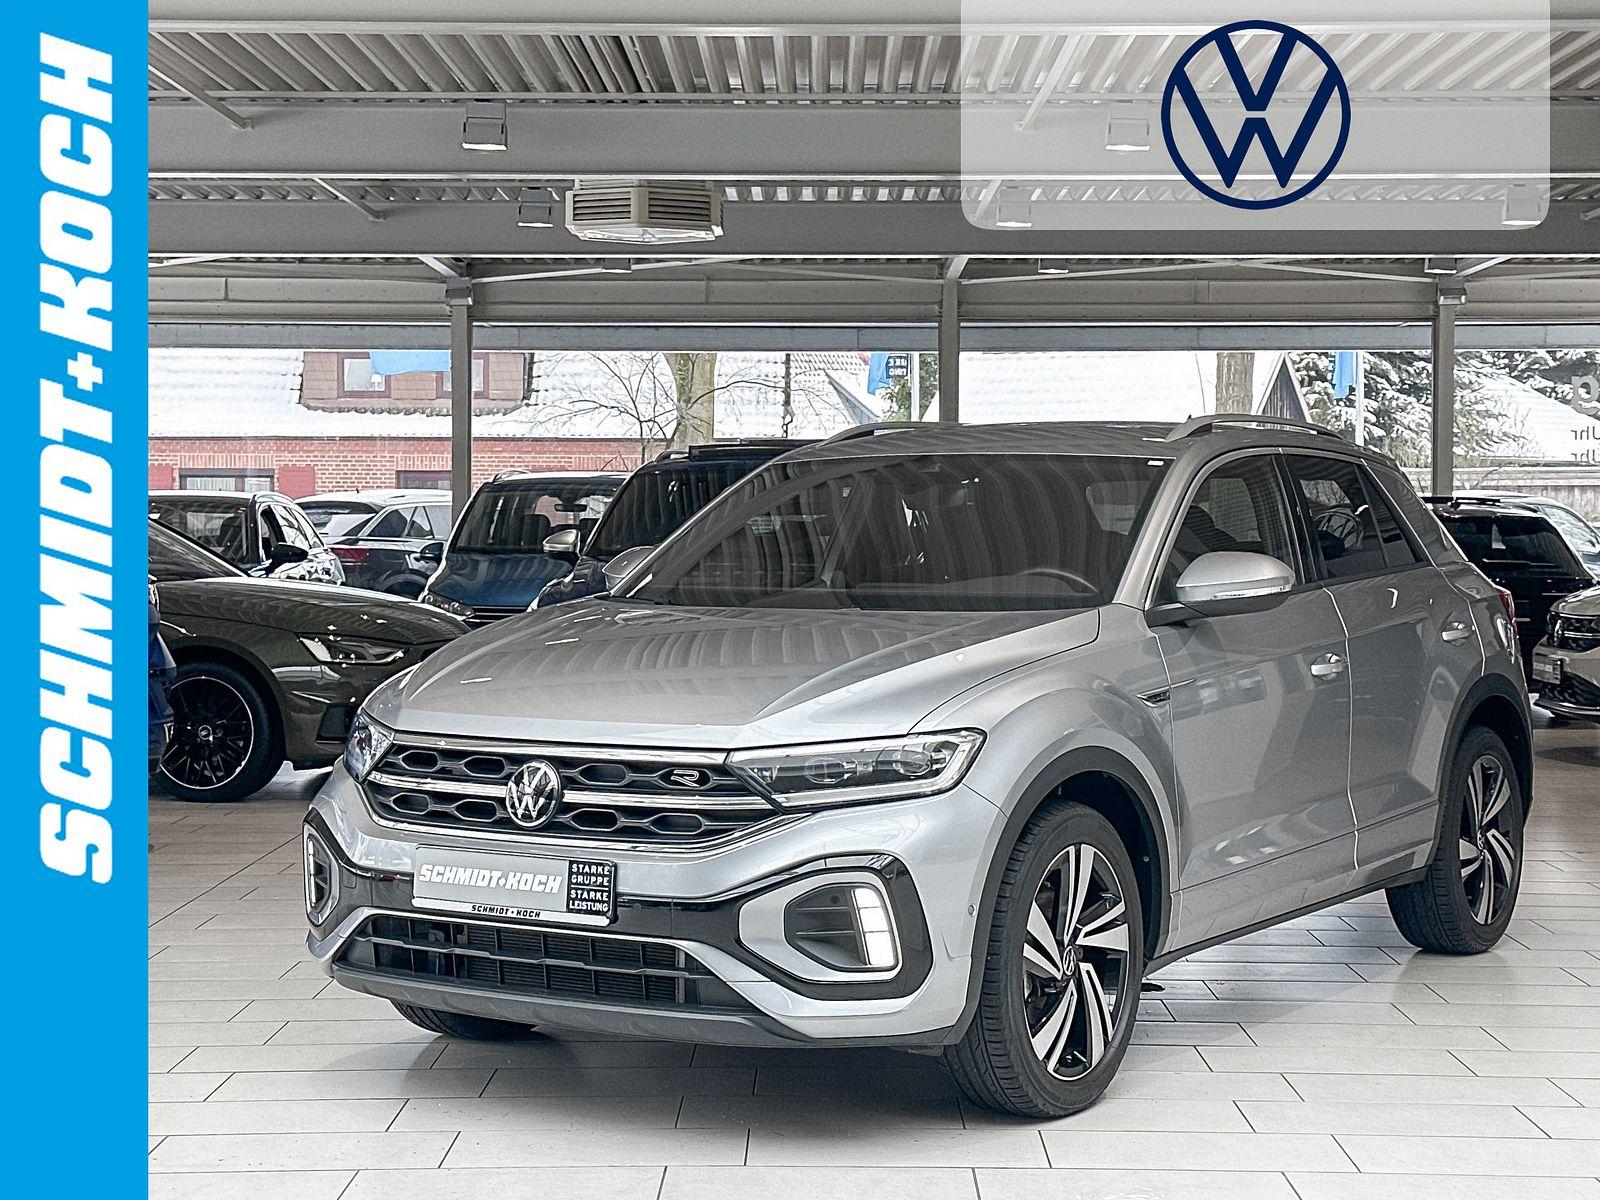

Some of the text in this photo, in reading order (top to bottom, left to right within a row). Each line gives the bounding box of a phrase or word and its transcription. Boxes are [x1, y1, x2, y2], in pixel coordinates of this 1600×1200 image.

[571, 863, 610, 875] STARKE
[571, 874, 609, 886] GRUPPE
[570, 889, 609, 901] STARKE
[569, 900, 609, 912] LEISTUNG
